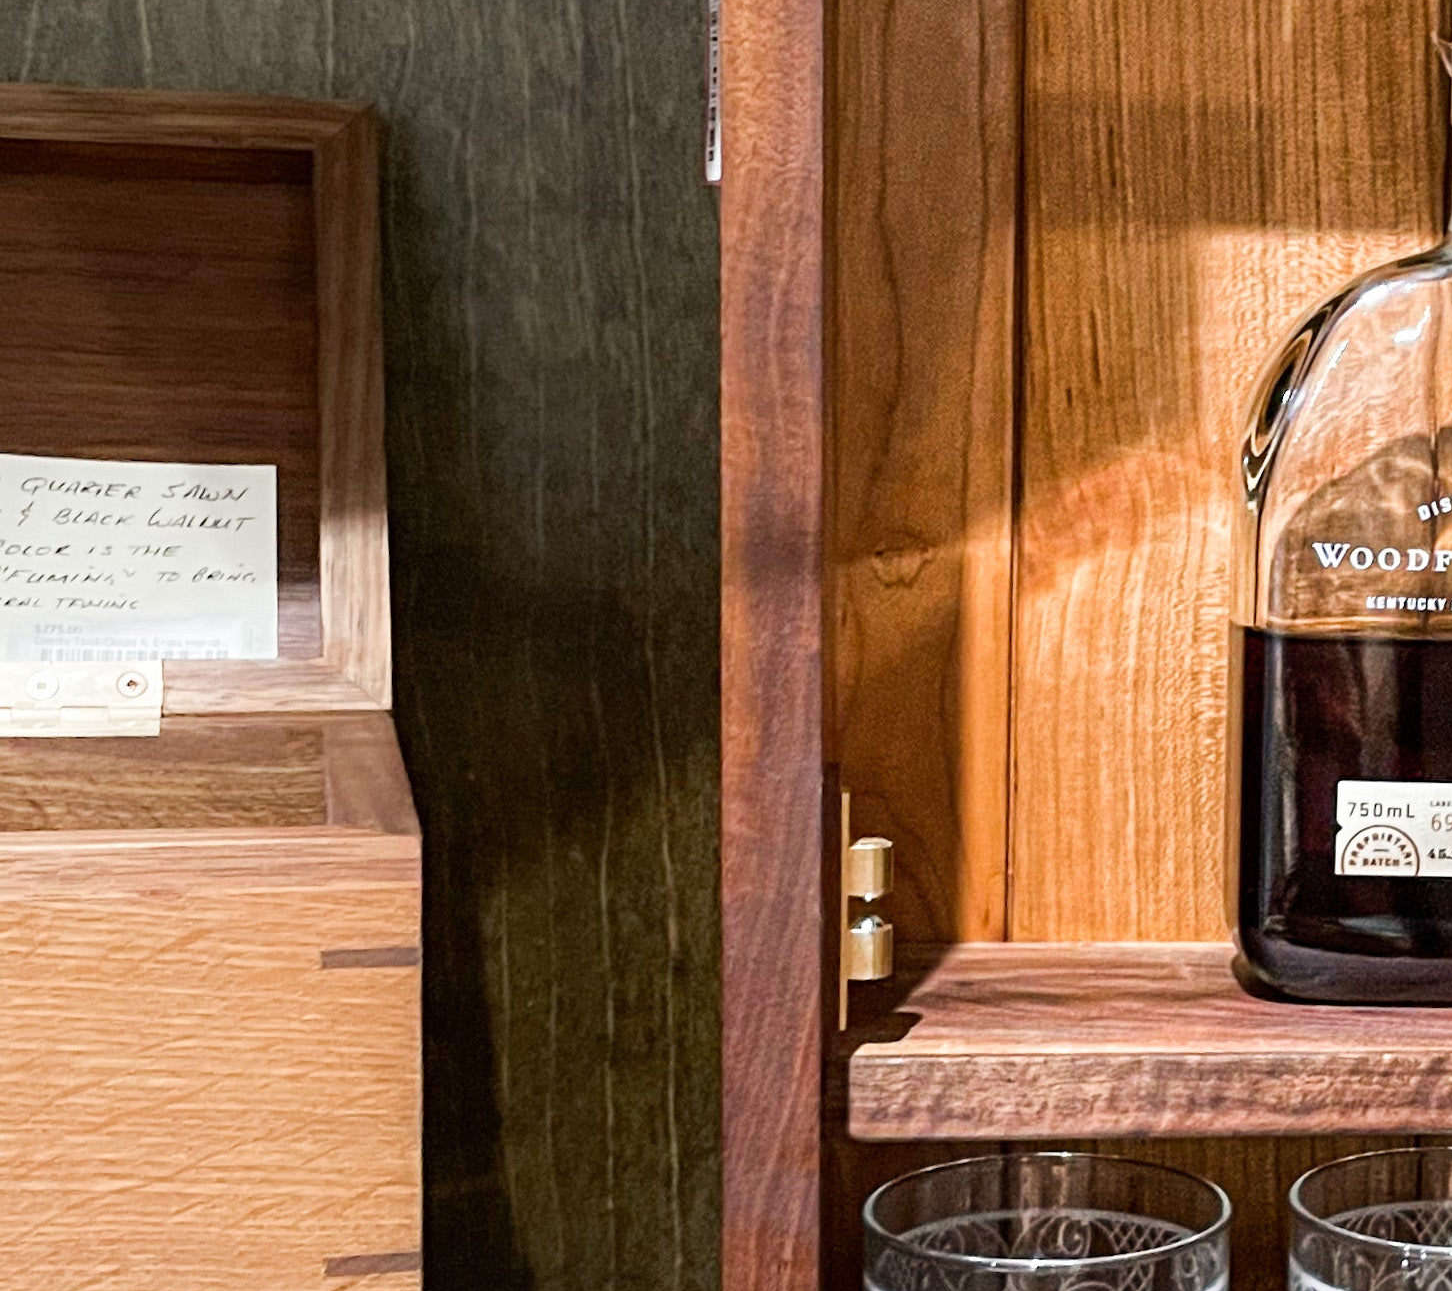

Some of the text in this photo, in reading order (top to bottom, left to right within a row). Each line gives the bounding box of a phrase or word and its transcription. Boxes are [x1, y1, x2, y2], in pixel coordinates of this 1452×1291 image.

[21, 476, 250, 503] QUARTER SAWN
[53, 507, 136, 527] BLACK
[128, 545, 182, 558] THE
[156, 571, 181, 583] TO
[1366, 596, 1446, 611] KENTUCKY
[1348, 802, 1415, 818] 750mL
